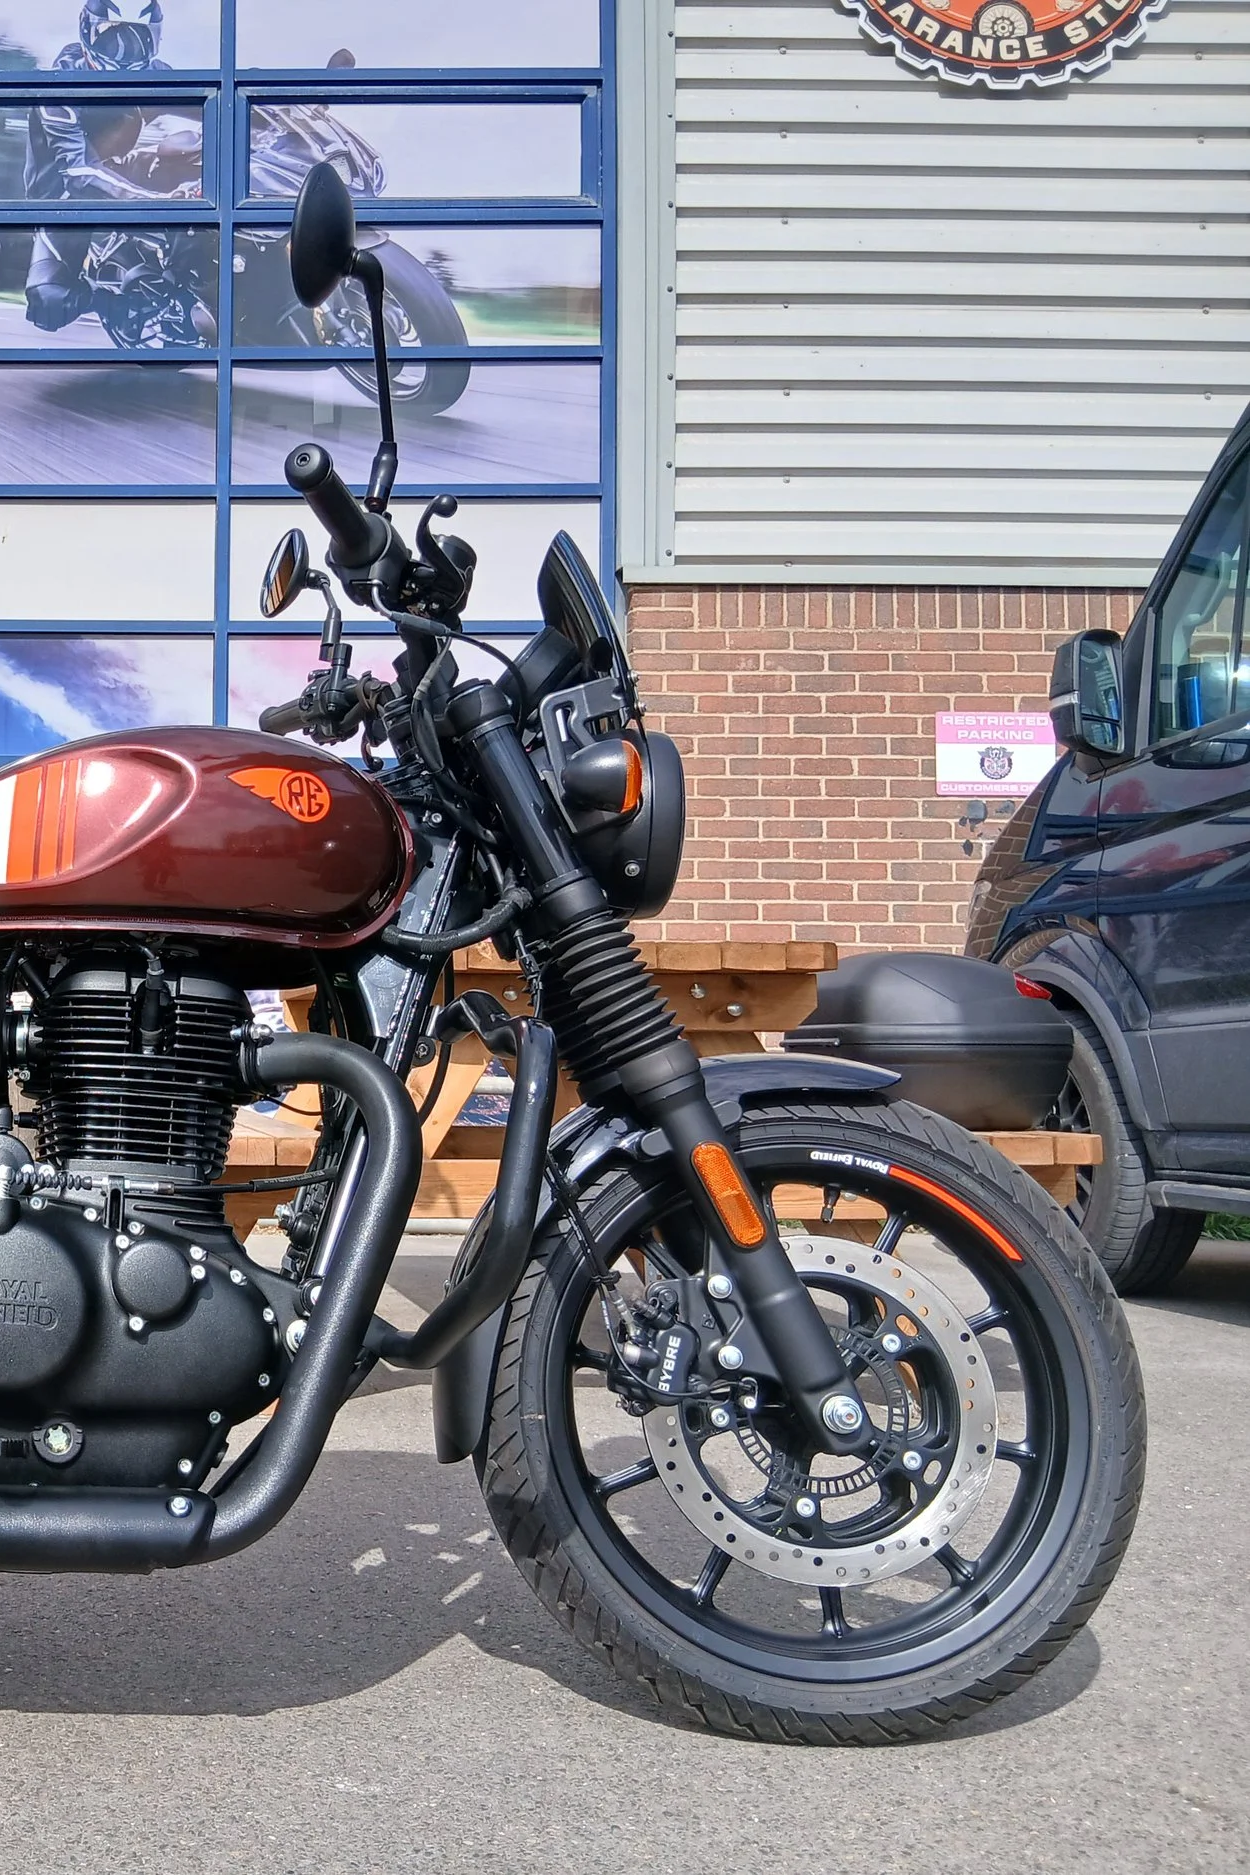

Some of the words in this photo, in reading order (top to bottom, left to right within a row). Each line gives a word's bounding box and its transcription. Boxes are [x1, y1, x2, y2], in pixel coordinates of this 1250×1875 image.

[877, 0, 1048, 62] ARANCE
[941, 715, 1049, 727] RESTRICTED
[957, 730, 1034, 740] PARKING
[286, 775, 325, 817] RE
[940, 784, 1018, 793] CUSTOMERS
[810, 1150, 854, 1165] ENFIELD
[853, 1156, 890, 1175] ROYAL
[657, 1335, 682, 1392] BYBRE
